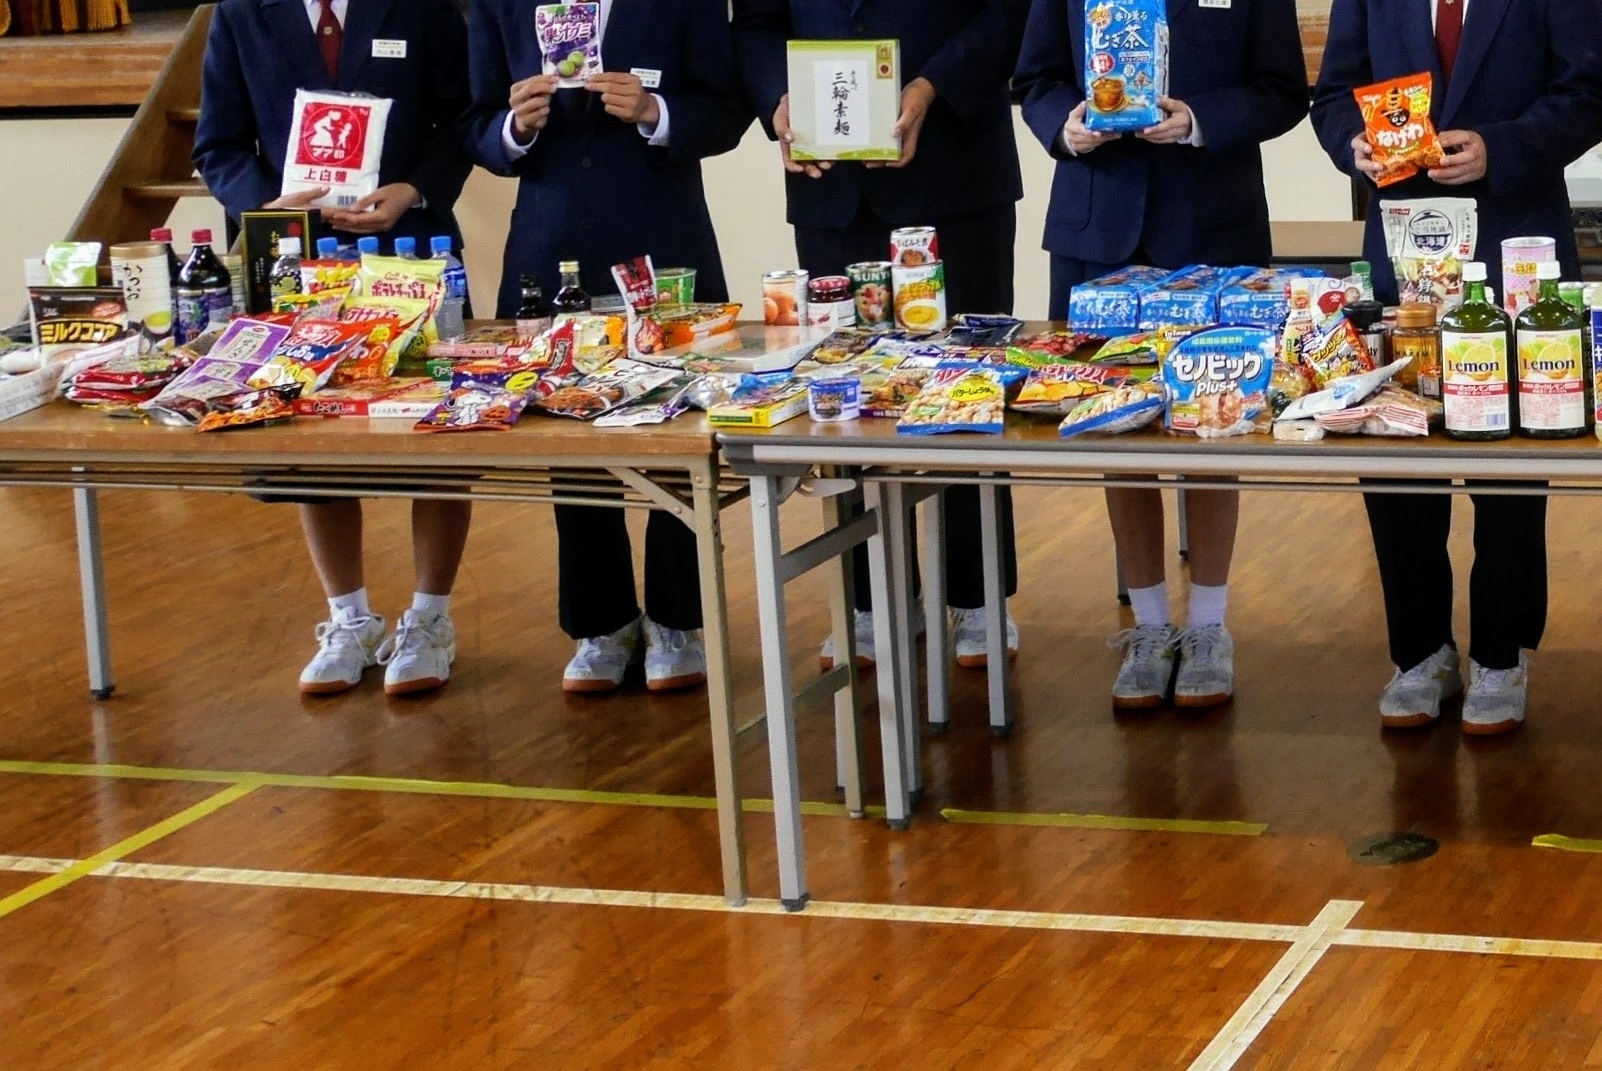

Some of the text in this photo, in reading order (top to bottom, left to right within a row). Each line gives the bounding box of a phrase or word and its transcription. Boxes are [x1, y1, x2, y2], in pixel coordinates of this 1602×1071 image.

[1093, 24, 1149, 50] むぎ茶
[1376, 123, 1424, 148] なげわ
[304, 168, 347, 183] 上白糖
[853, 271, 890, 282] SUNY
[1170, 303, 1207, 320] むぎ茶
[1249, 303, 1288, 319] むぎ茶
[39, 322, 119, 344] ミルクココア
[1172, 352, 1263, 382] セノビック
[1448, 360, 1500, 373] Lemon
[1523, 358, 1575, 371] Lemon
